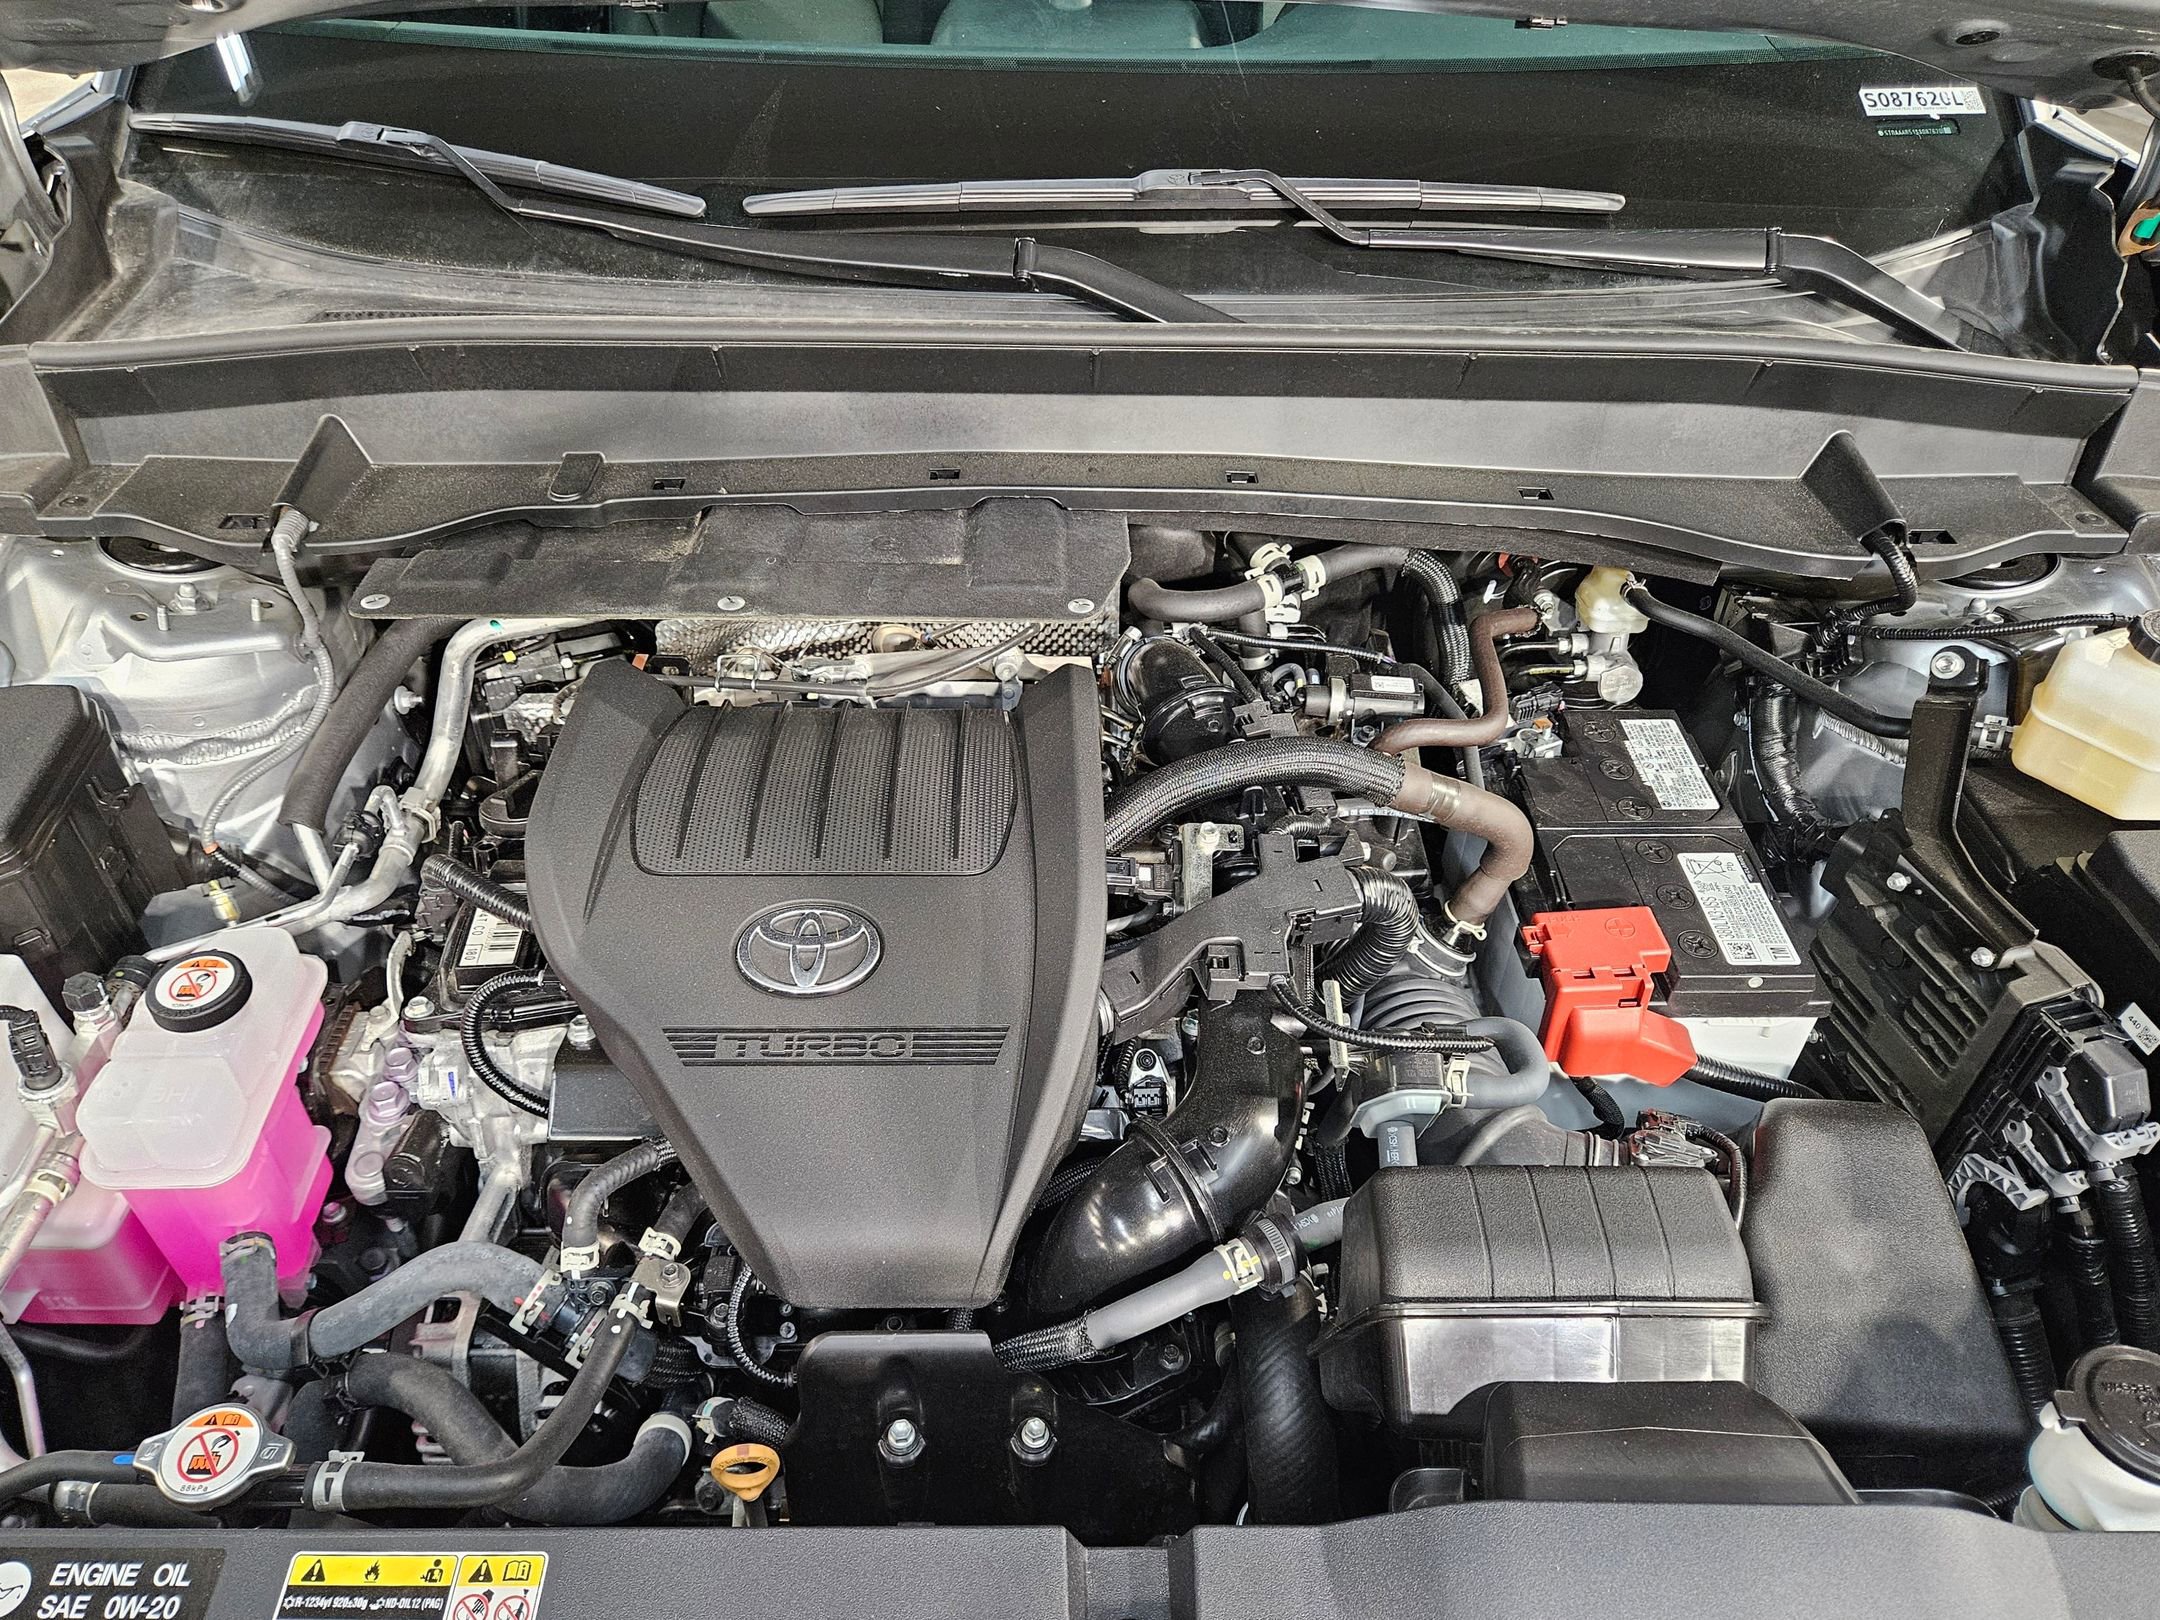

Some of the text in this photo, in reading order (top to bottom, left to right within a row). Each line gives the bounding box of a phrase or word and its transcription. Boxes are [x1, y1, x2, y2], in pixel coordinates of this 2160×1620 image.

[1864, 91, 1963, 107] S087620L
[2128, 1016, 2141, 1029] 440
[718, 1032, 908, 1059] TURBO
[49, 1562, 192, 1587] ENGINE OIL
[37, 1593, 182, 1620] SAE 0W-20
